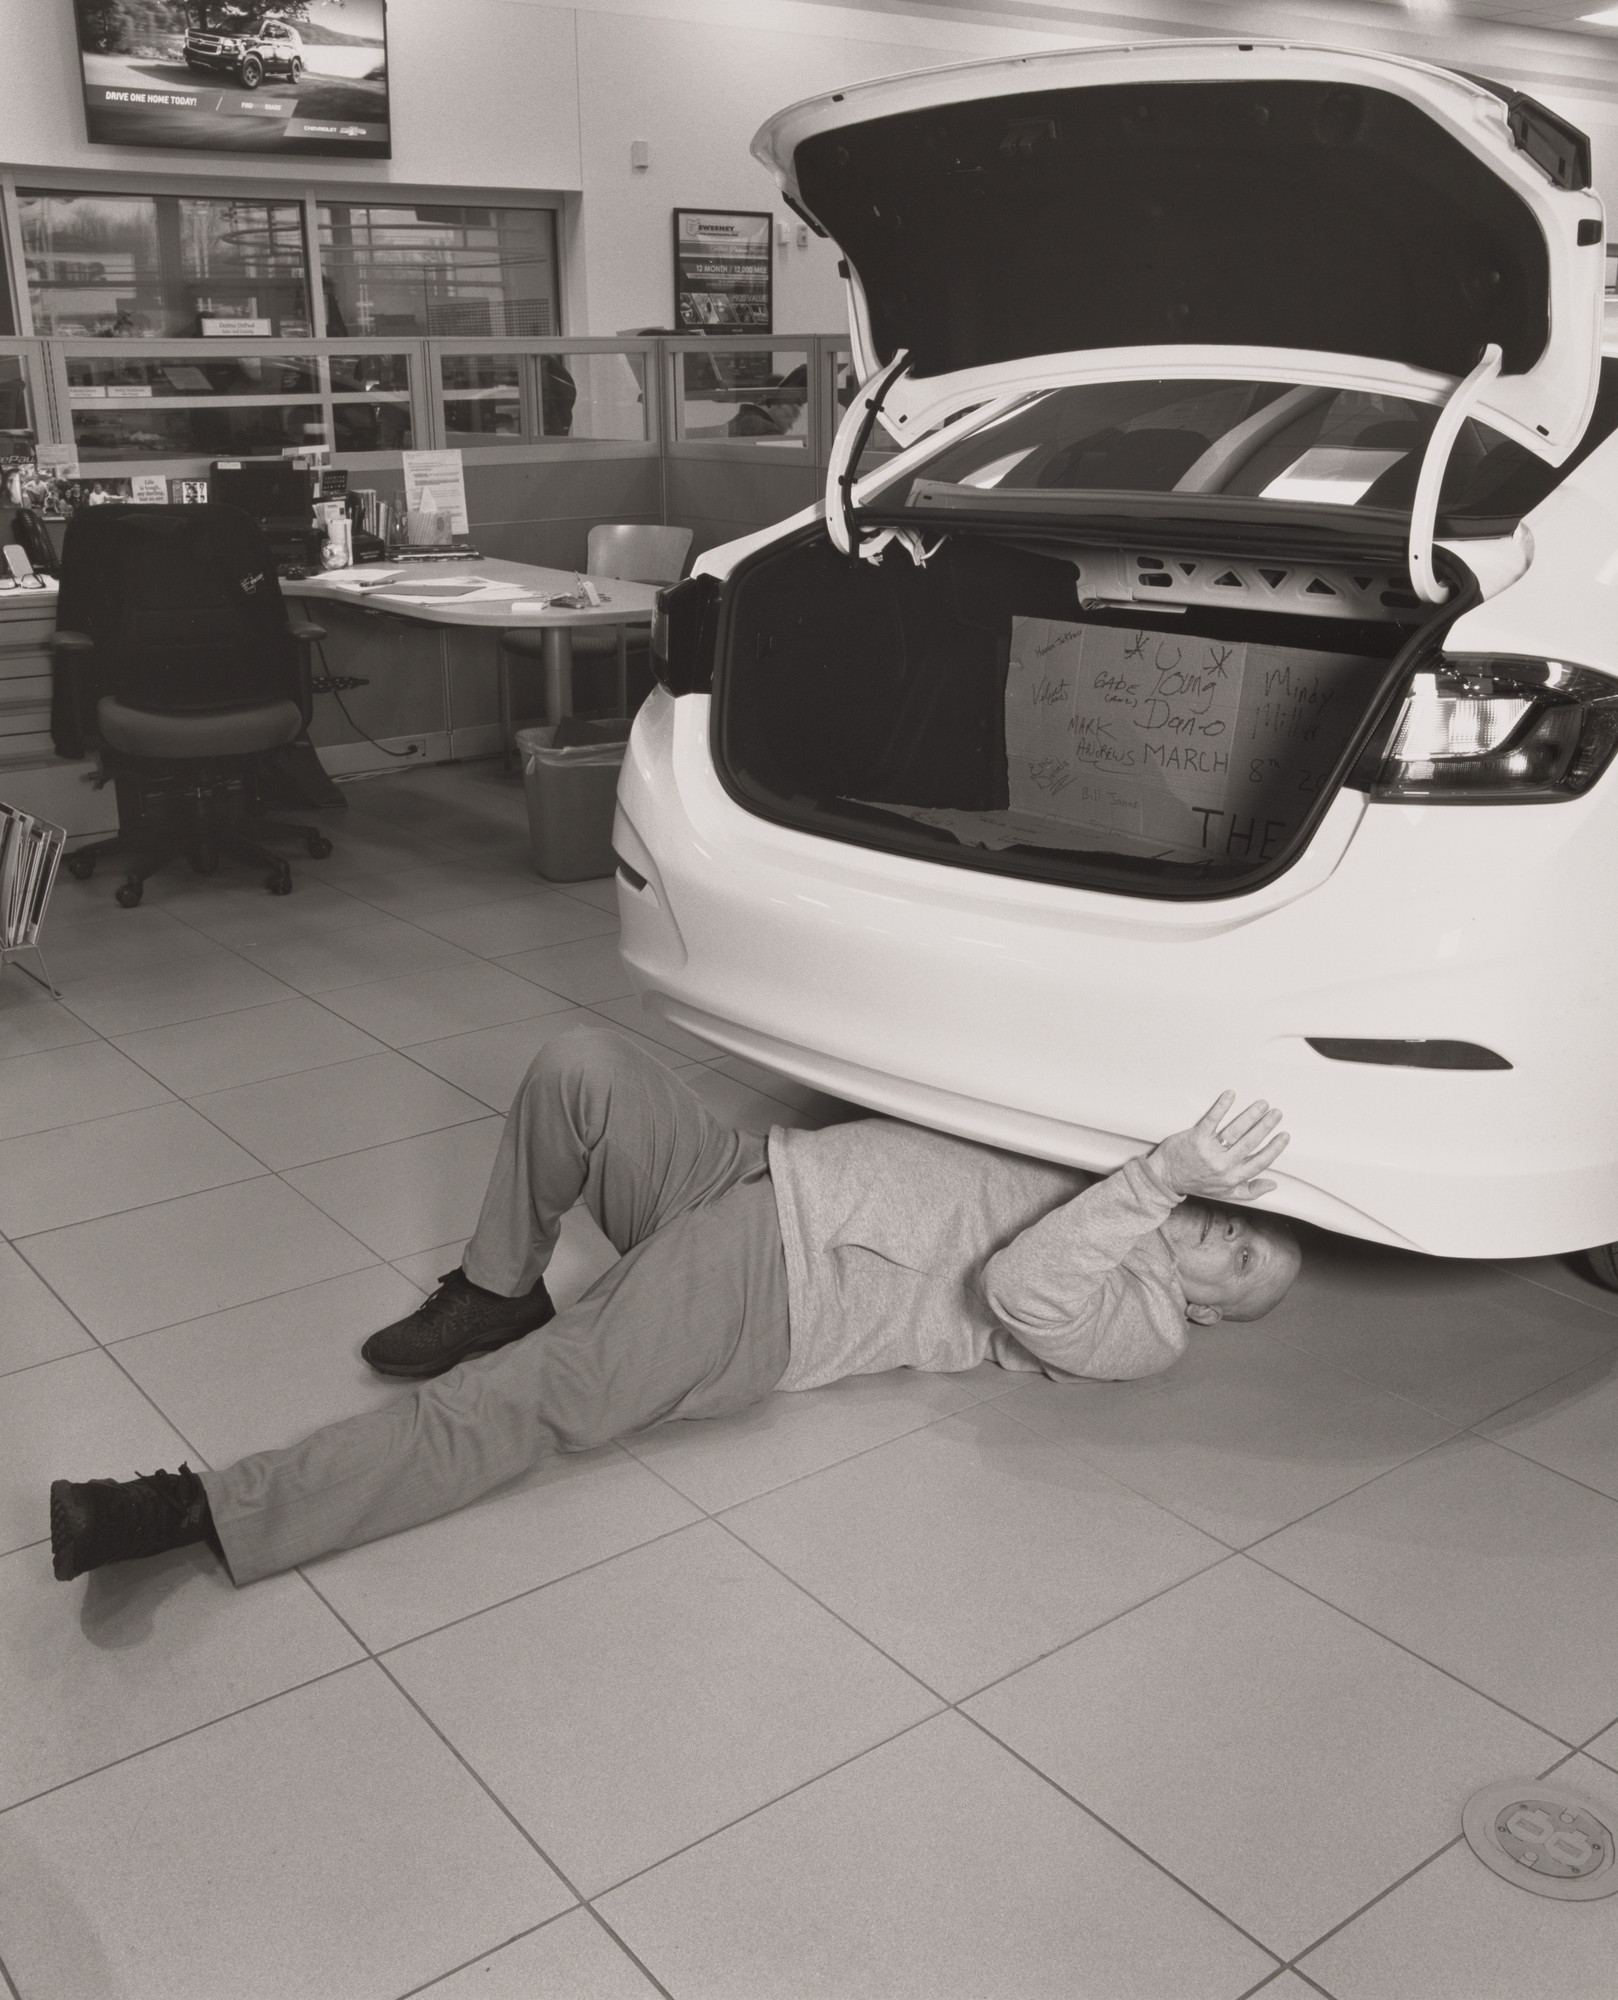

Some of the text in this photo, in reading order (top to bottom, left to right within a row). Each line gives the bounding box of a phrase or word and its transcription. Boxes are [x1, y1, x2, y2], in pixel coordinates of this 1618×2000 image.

[105, 90, 198, 106] DRIVE ONE HOME TODAY!
[303, 125, 338, 133] CHEVROLET
[697, 224, 735, 232] SWEENEY
[696, 264, 704, 273] 12
[704, 264, 728, 274] MONTH
[753, 266, 768, 275] MILE
[1264, 666, 1336, 718] Mindy
[1067, 715, 1118, 741] MARK
[1143, 742, 1230, 774] MARCH
[1081, 786, 1101, 801] Bill
[1191, 806, 1287, 861] THE
